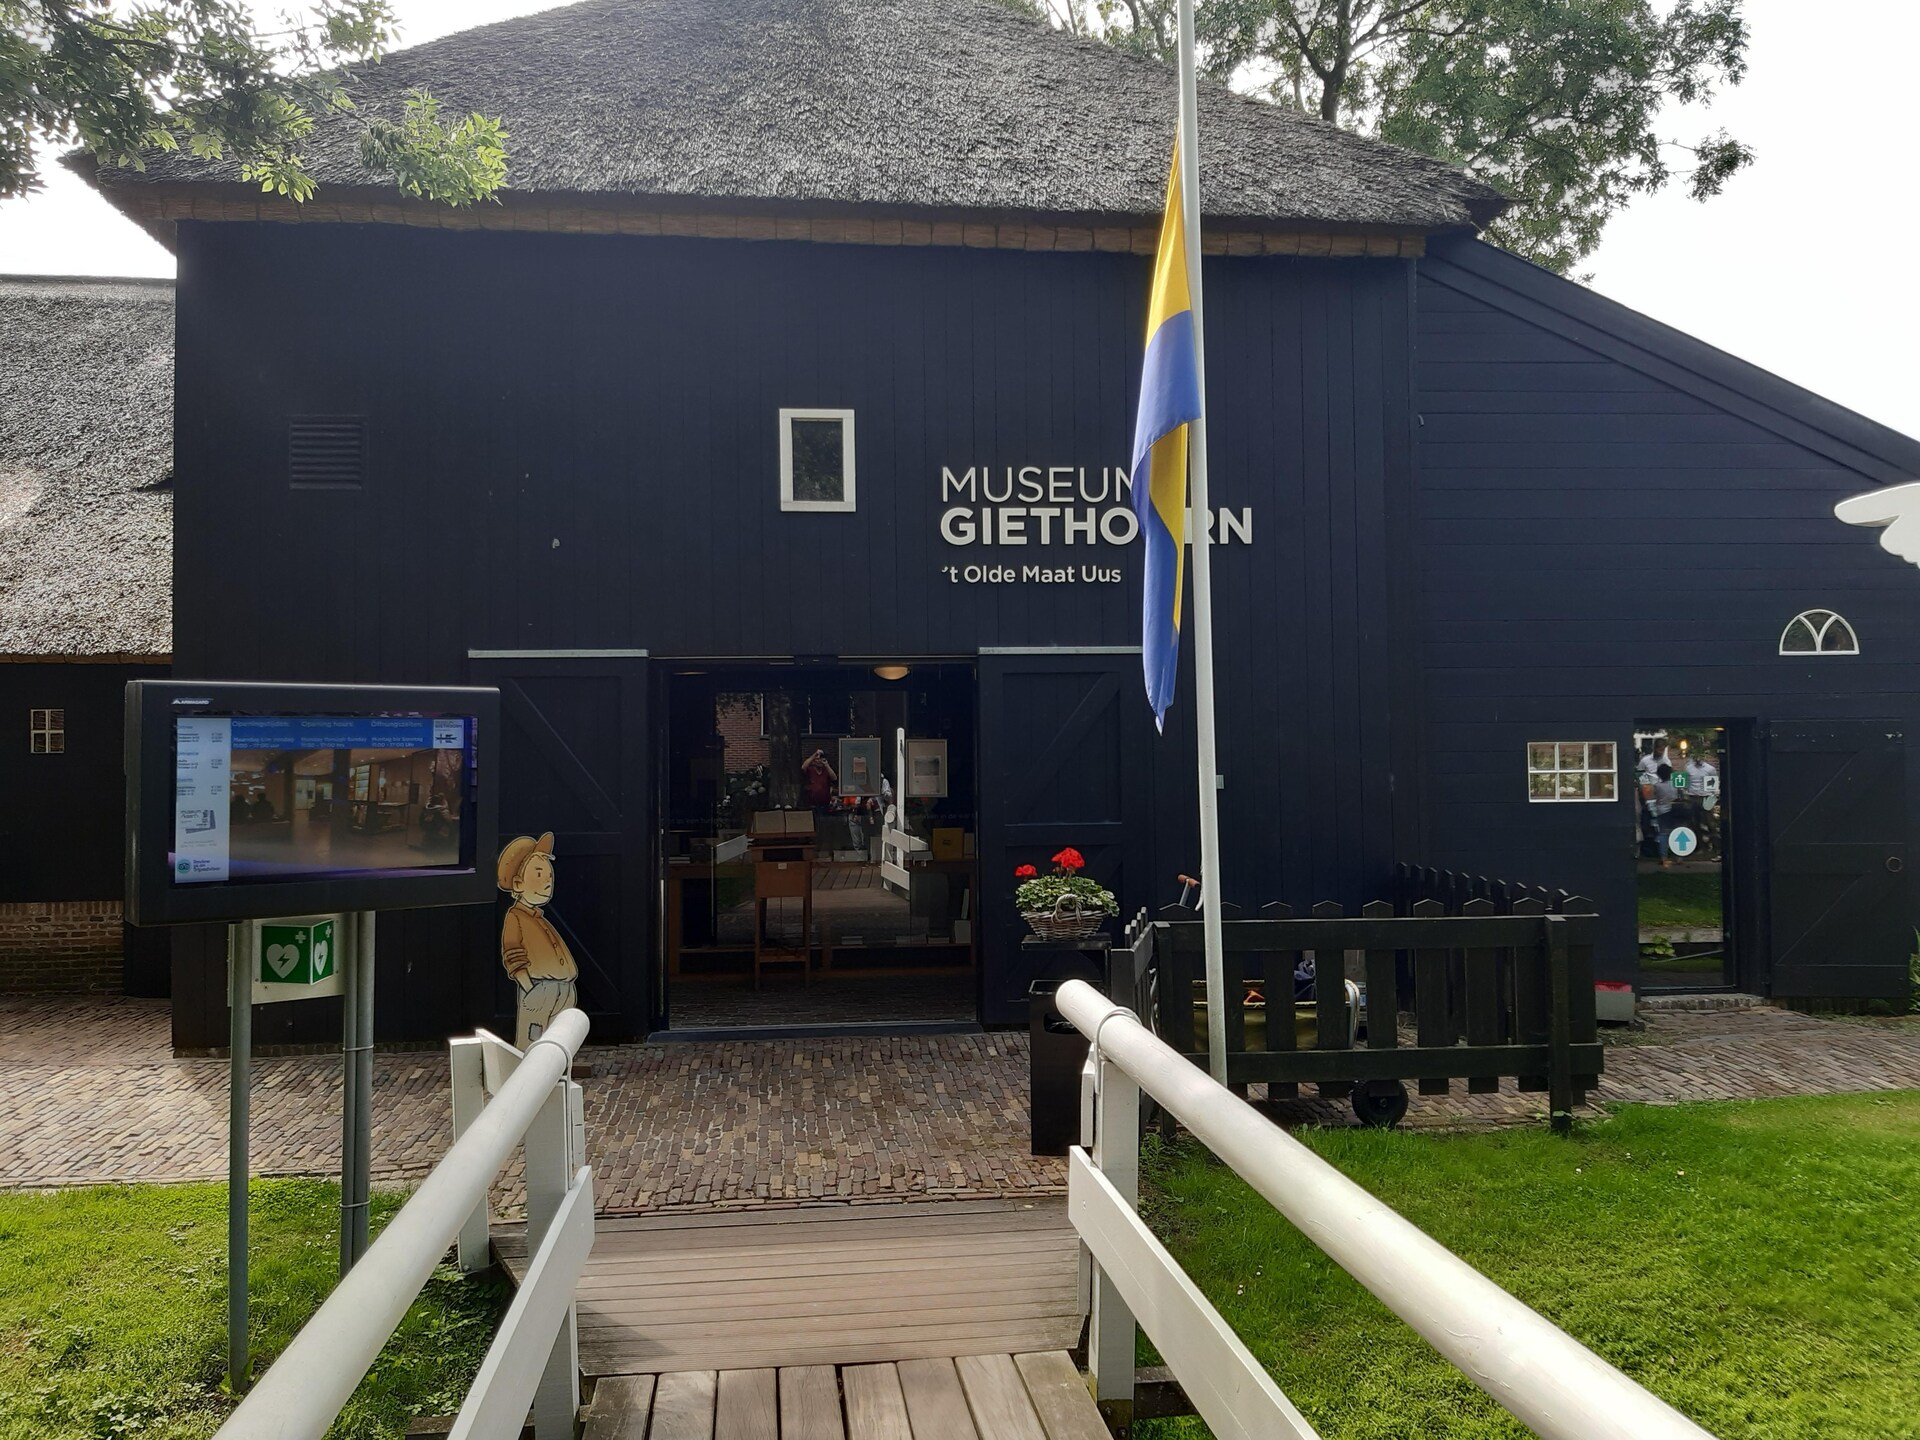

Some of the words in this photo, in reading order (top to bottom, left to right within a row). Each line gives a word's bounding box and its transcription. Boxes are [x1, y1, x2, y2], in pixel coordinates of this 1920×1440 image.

[940, 507, 1252, 545] GIETHORN
[963, 565, 1016, 583] Olde
[1022, 565, 1075, 583] Maat
[1081, 565, 1122, 583] Uus
